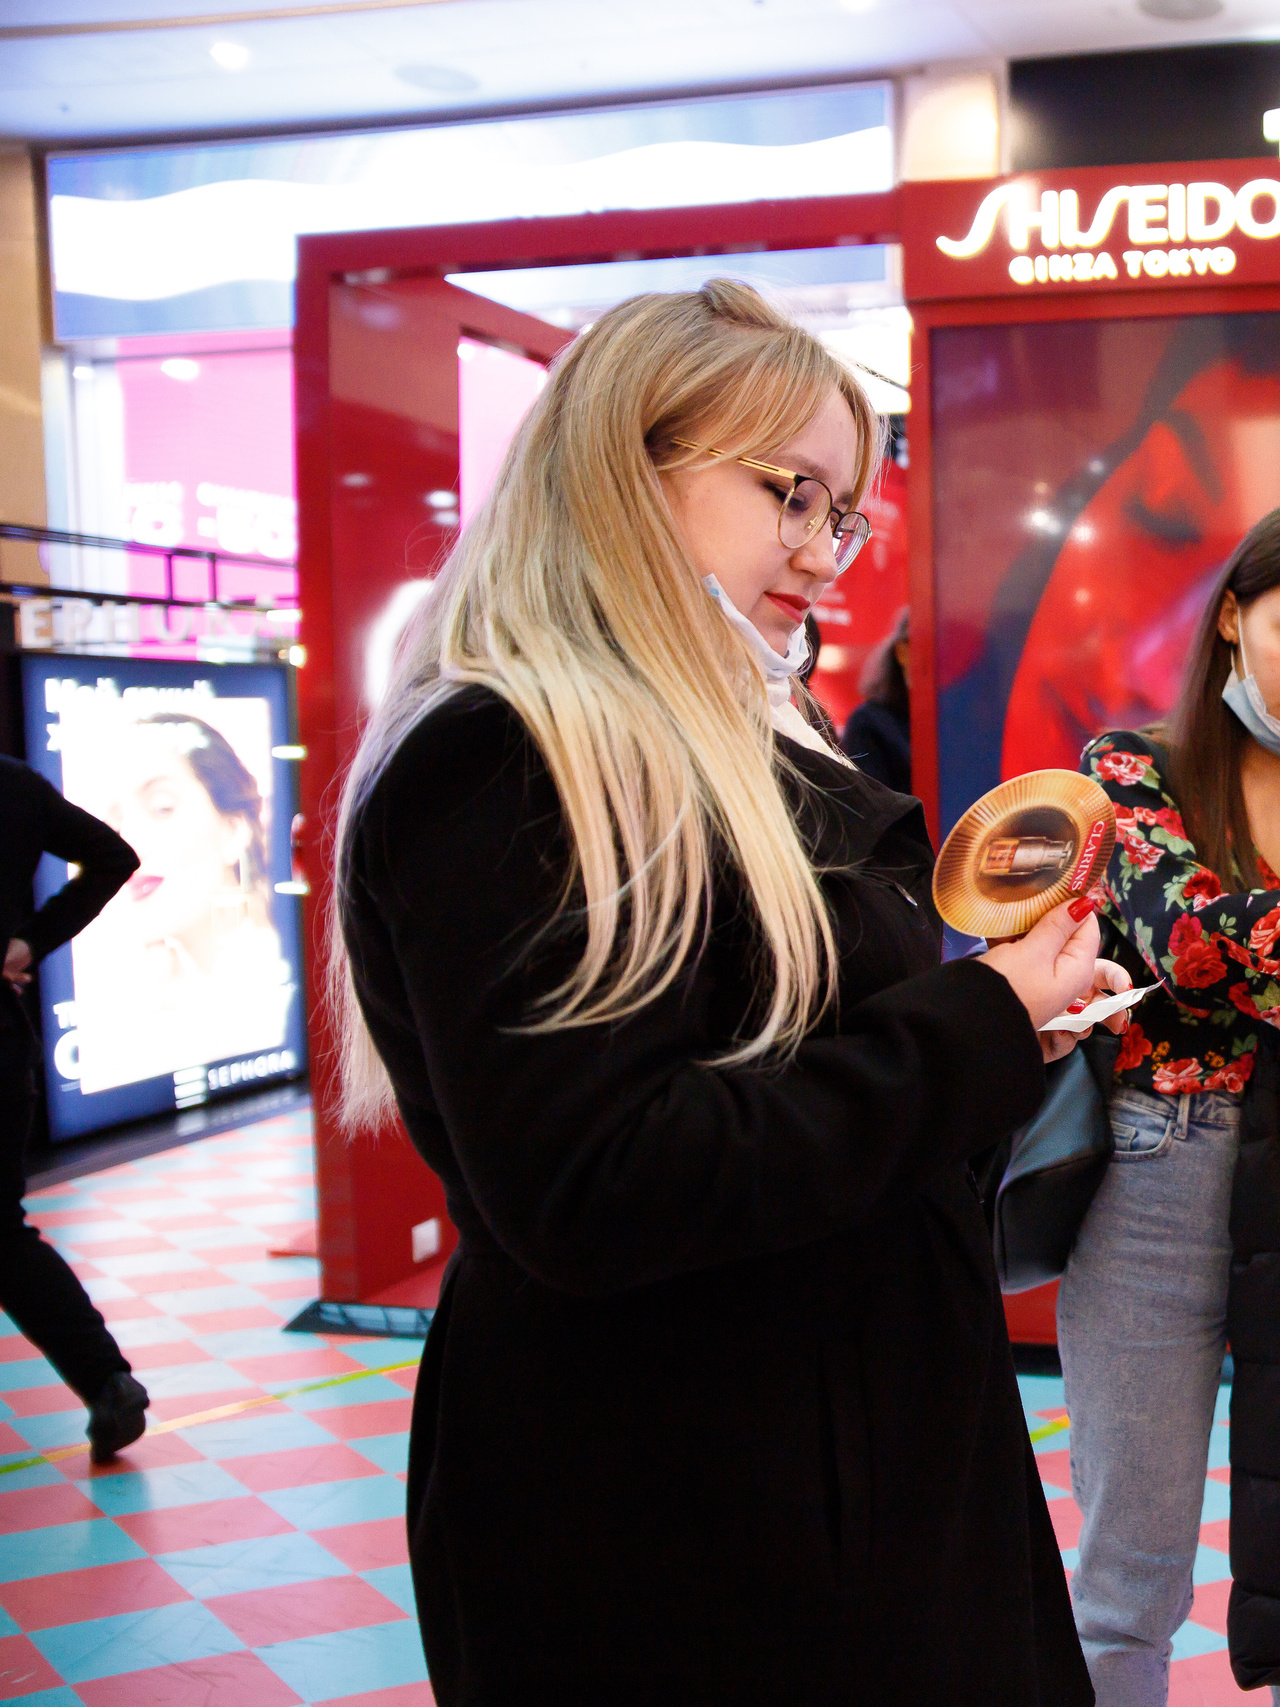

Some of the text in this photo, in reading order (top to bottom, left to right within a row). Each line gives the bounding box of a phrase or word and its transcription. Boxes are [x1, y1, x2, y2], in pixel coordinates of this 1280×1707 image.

[1009, 247, 1236, 284] GINZA TOKYO
[1071, 820, 1105, 891] CLARINS
[208, 1050, 297, 1090] SEPHORA
